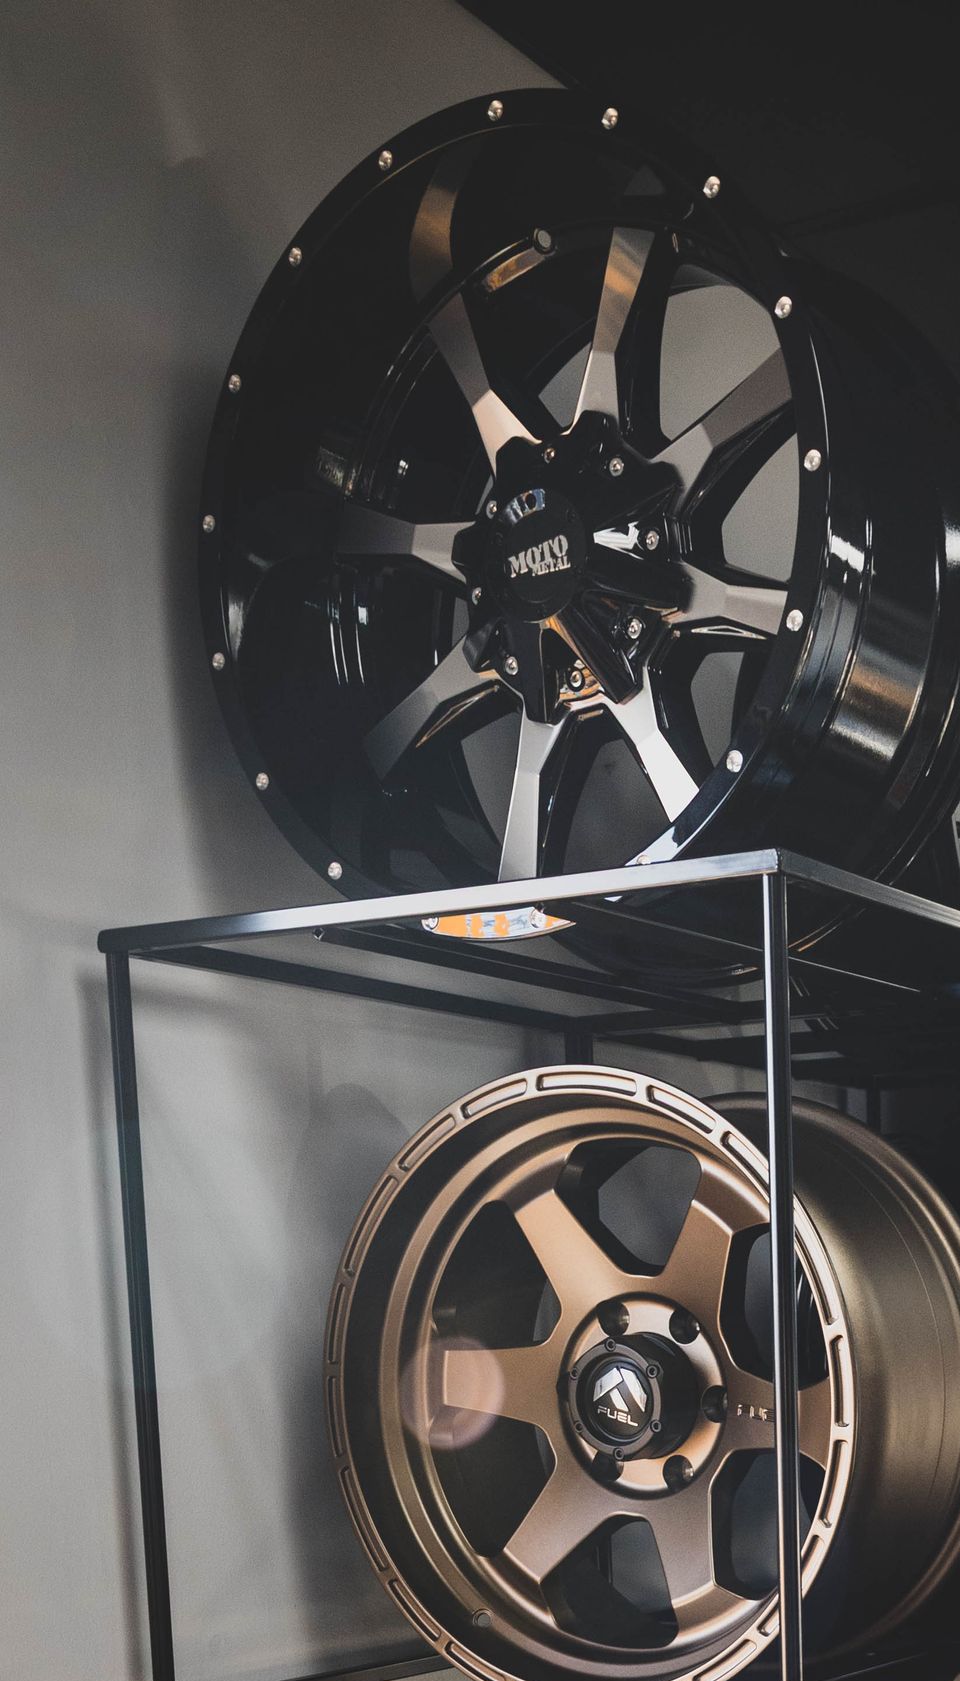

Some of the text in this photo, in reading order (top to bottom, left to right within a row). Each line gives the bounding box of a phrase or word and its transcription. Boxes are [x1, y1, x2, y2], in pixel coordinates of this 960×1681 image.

[508, 534, 569, 578] MOTO
[532, 555, 571, 577] METAL
[597, 1405, 639, 1427] FUEL
[736, 1403, 776, 1423] FUE
